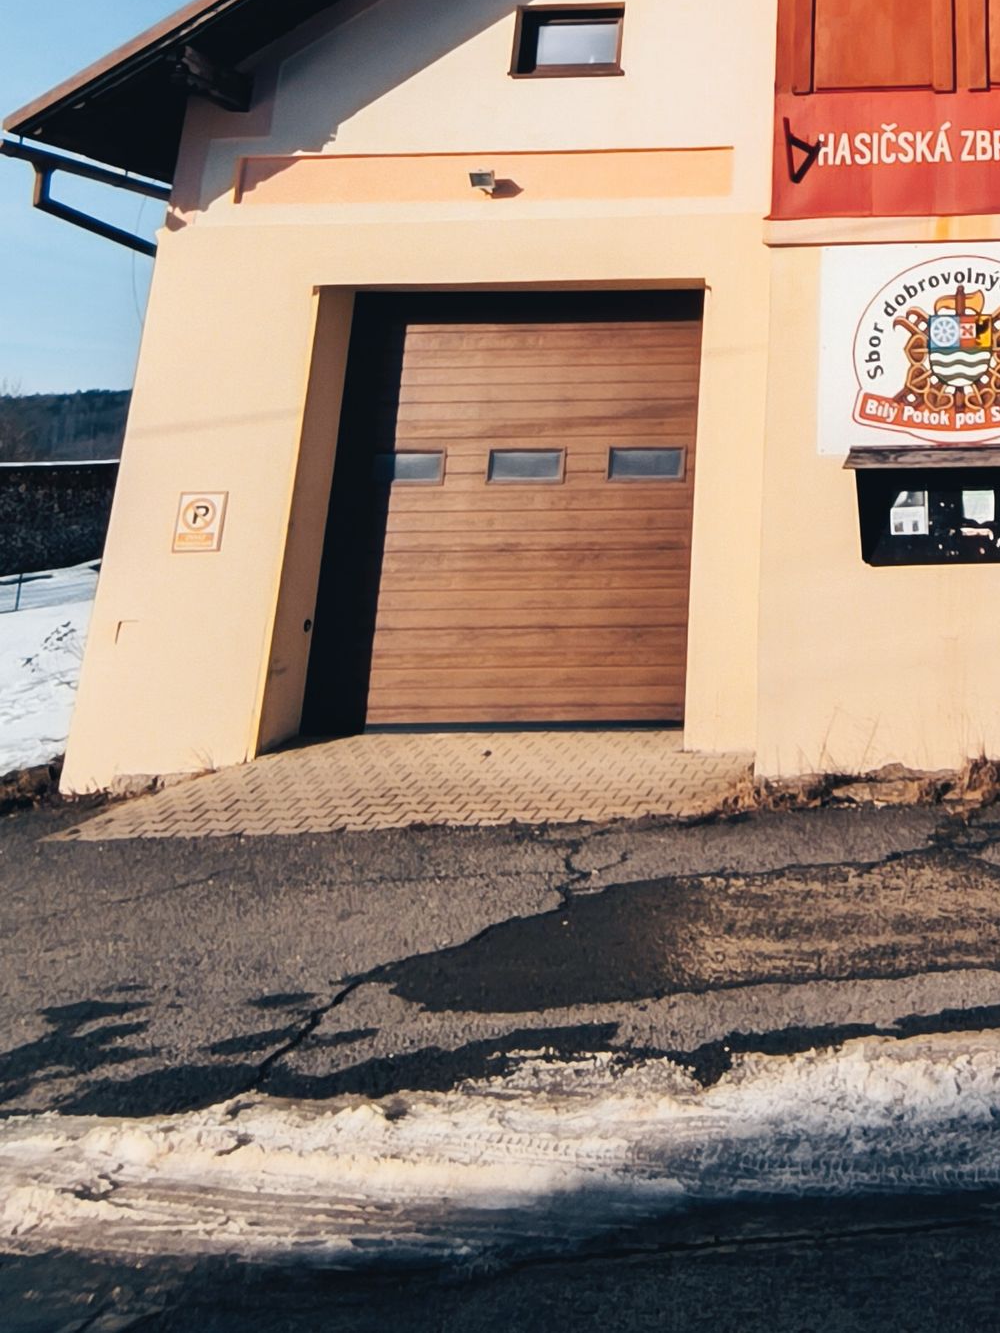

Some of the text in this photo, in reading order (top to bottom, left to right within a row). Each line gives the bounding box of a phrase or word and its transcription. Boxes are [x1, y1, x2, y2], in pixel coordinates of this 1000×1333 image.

[817, 121, 953, 166] HASIČSKÁ
[865, 322, 885, 380] Sbor
[903, 405, 950, 426] Potok
[955, 409, 985, 429] pod
[192, 505, 210, 525] P
